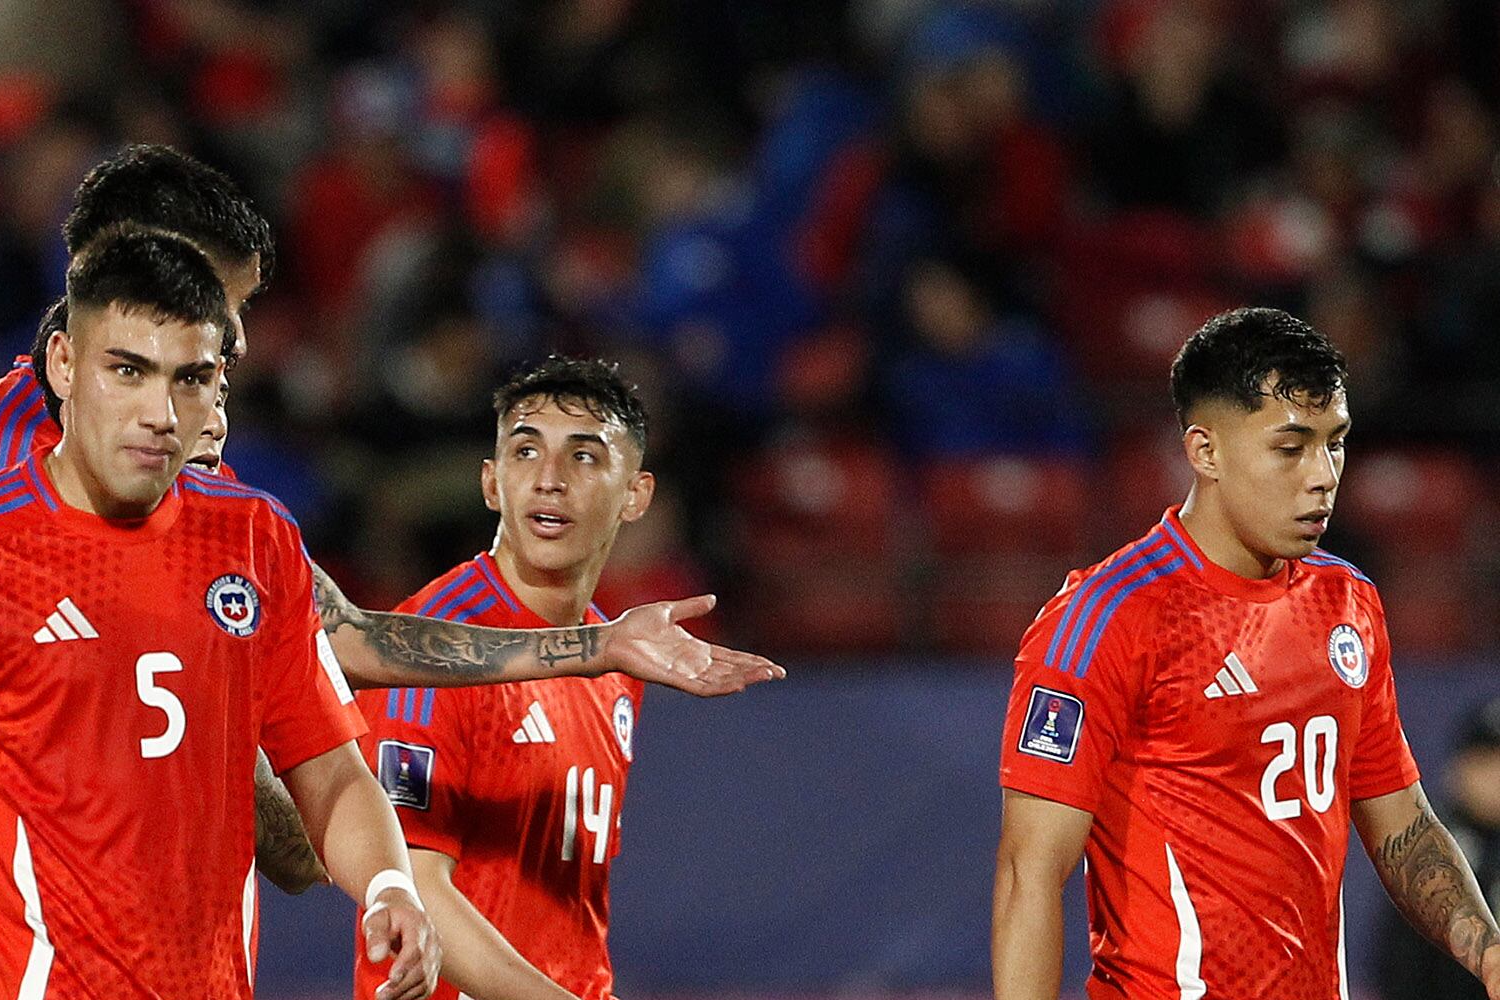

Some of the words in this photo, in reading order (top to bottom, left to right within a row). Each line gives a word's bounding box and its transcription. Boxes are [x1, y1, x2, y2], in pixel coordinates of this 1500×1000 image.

[135, 652, 186, 759] 5
[561, 765, 613, 864] 14
[1260, 715, 1338, 821] 20
